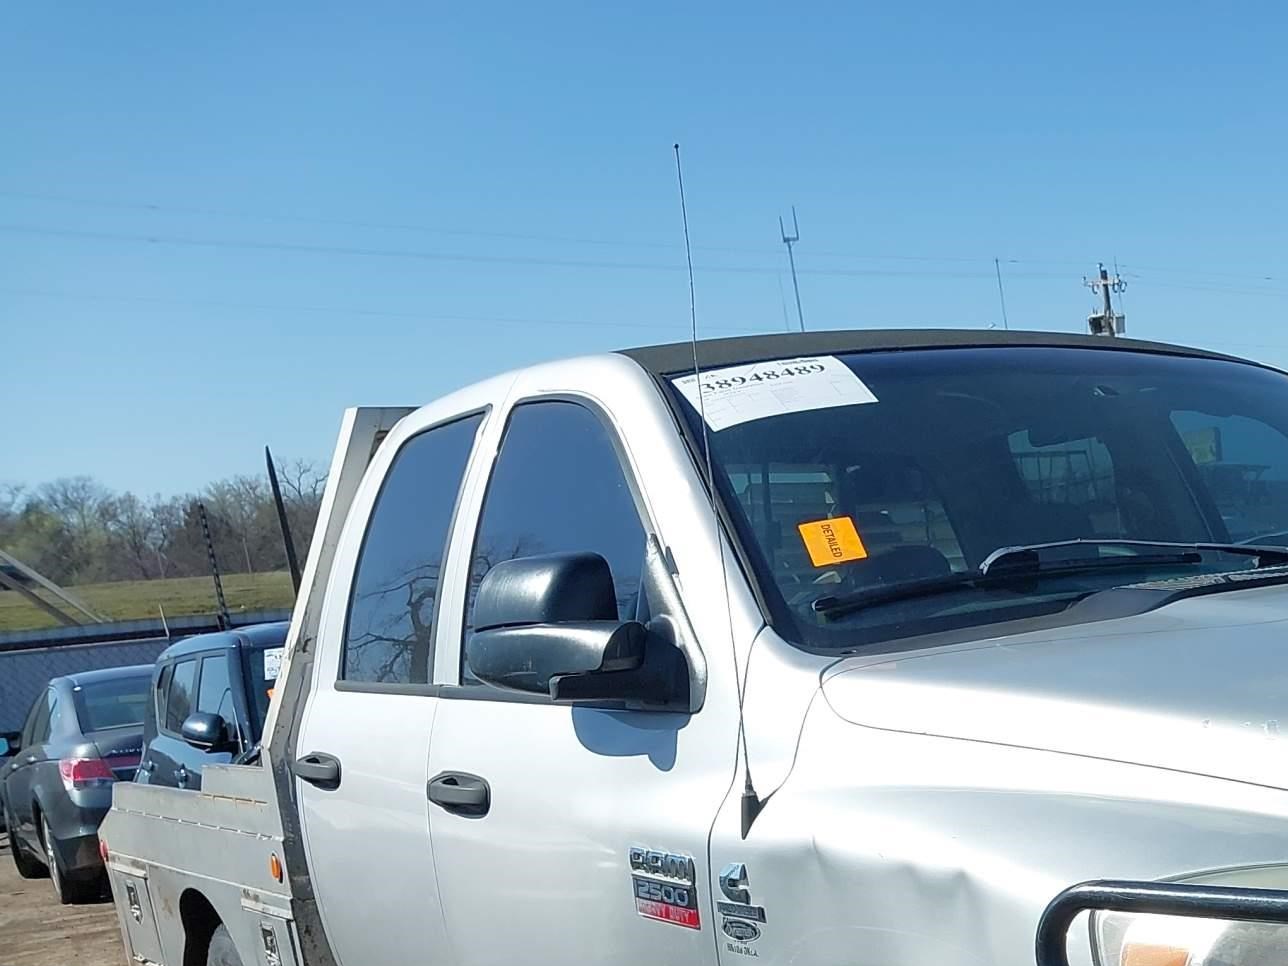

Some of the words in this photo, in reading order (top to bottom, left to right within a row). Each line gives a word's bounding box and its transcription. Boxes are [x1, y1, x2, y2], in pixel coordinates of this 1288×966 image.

[700, 364, 825, 391] 38948489
[820, 523, 843, 558] DETAILED
[637, 881, 689, 906] 2500
[669, 907, 690, 923] DUTY
